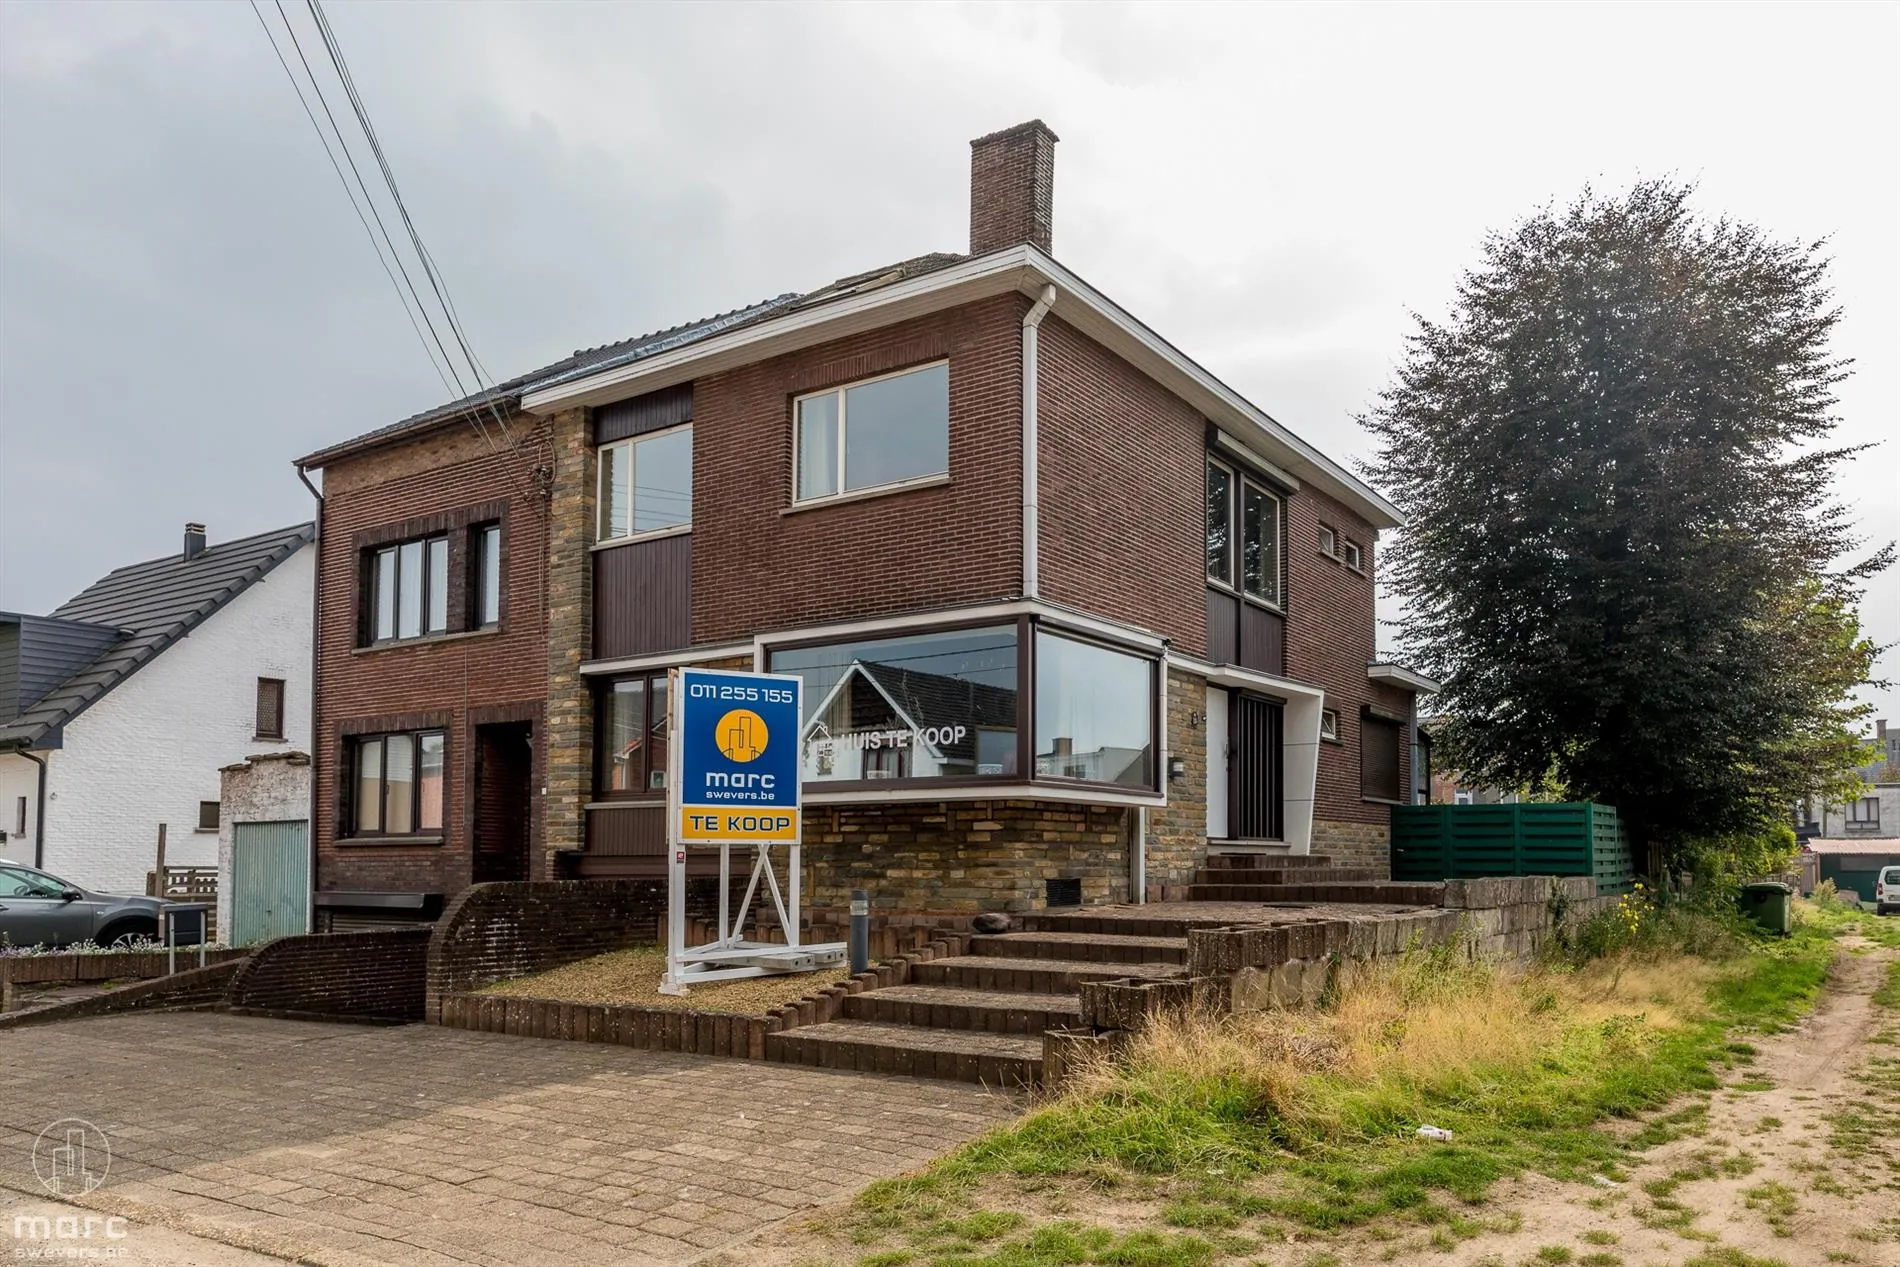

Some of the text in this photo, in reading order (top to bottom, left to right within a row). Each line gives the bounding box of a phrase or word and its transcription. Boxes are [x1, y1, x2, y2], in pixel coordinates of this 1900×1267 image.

[690, 684, 793, 704] 011 255 155
[886, 730, 907, 748] TE
[913, 725, 966, 746] KOOP
[705, 772, 776, 789] marc
[705, 790, 775, 800] swevers.be
[689, 815, 790, 832] TE KOOP
